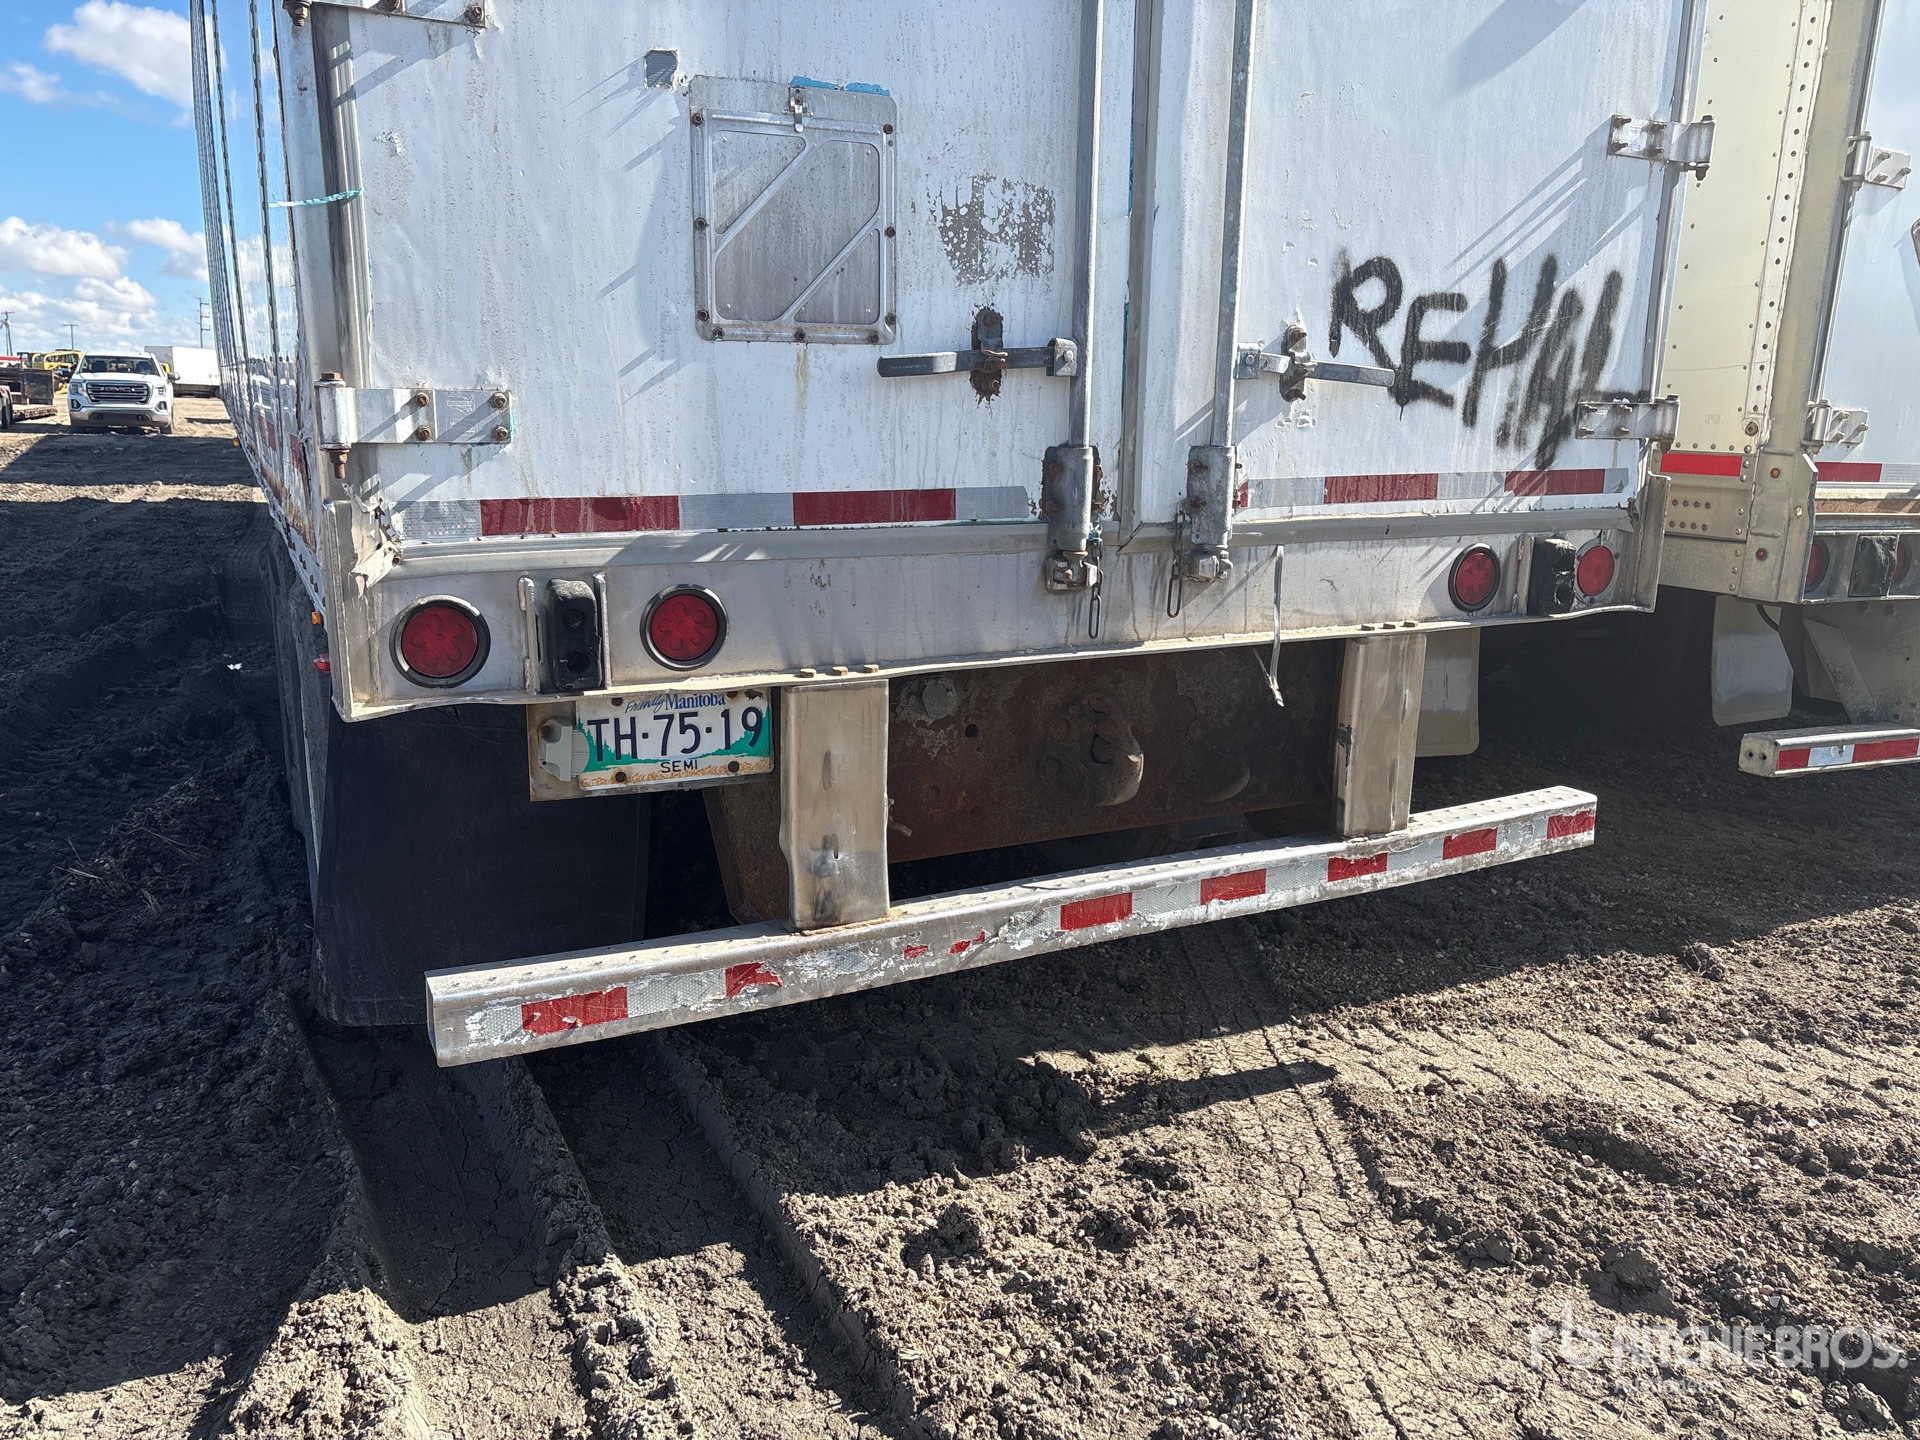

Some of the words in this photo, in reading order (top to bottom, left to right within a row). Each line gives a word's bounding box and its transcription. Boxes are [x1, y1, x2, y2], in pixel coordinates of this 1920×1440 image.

[625, 694, 665, 713] Friendly
[665, 693, 725, 709] Manitoba
[660, 760, 698, 773] SEMI
